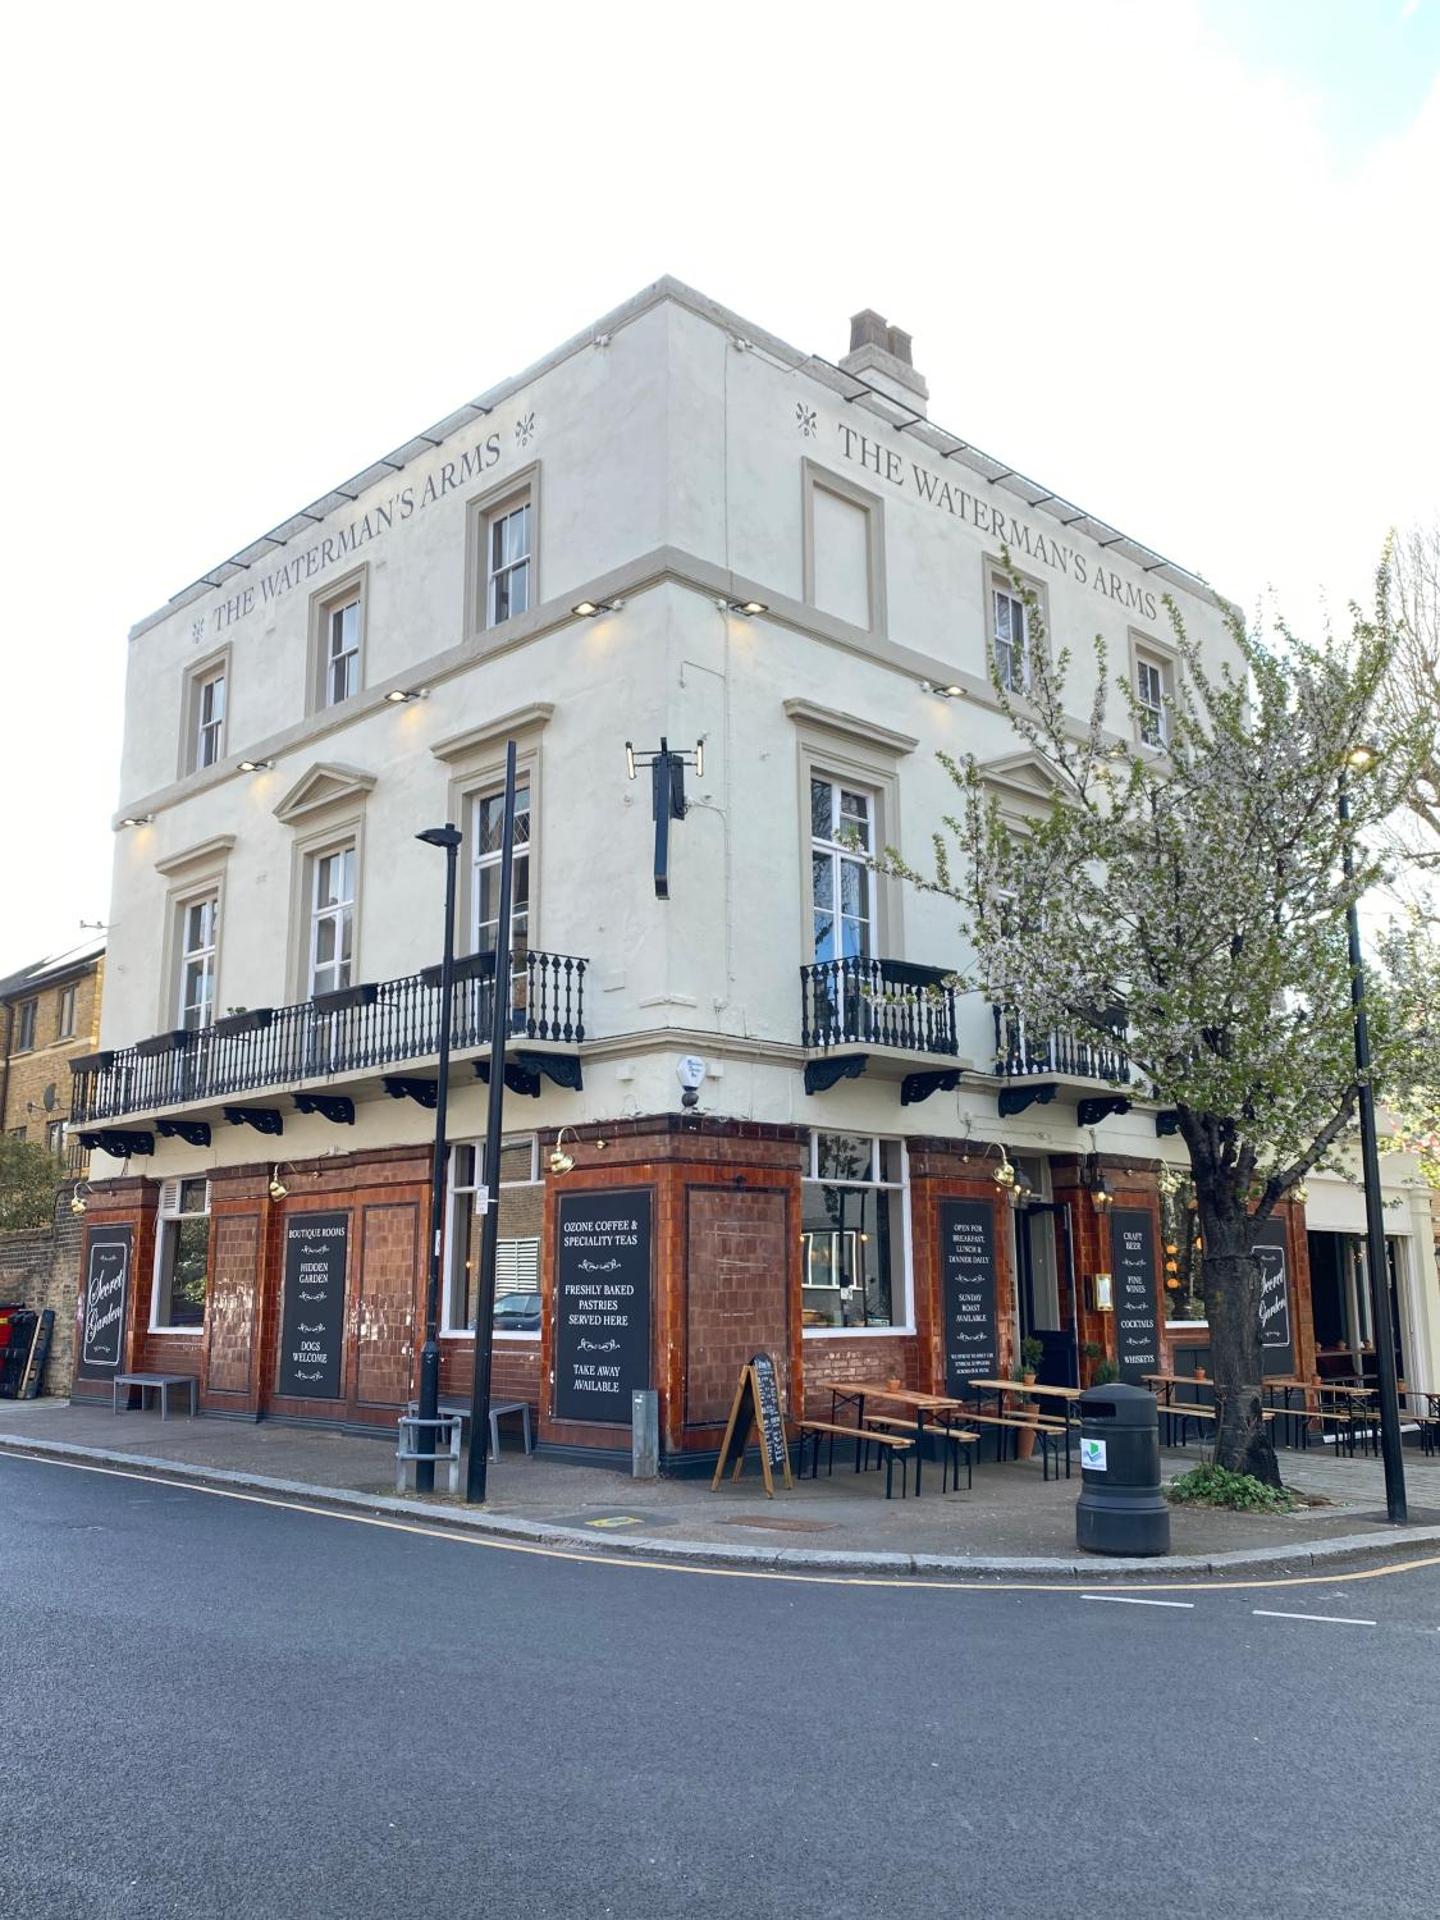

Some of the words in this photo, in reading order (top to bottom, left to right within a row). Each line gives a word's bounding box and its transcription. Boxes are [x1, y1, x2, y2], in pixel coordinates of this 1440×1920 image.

[838, 423, 905, 487] THE
[911, 464, 1088, 584] WATERMAN'S
[1093, 565, 1158, 621] ARMS
[213, 586, 255, 632] THE
[260, 486, 415, 604] WATERMAN'S
[420, 432, 501, 509] ARMS
[564, 1221, 594, 1232] OZONE
[595, 1220, 629, 1231] COFFEE
[631, 1220, 638, 1230] &
[954, 1224, 970, 1232] OPEN
[289, 1229, 321, 1239] BOUTIQUE
[322, 1227, 345, 1237] ROOMS
[1123, 1232, 1142, 1241] CRAFT
[564, 1236, 613, 1247] SPECIALITY
[615, 1235, 638, 1245] TEAS
[1126, 1241, 1142, 1250] BEER
[956, 1245, 976, 1253] LUNCH
[973, 1256, 990, 1264] DAILY
[300, 1263, 328, 1272] HIDDEN
[299, 1273, 328, 1284] GARDEN
[1128, 1276, 1142, 1285] FINE
[89, 1269, 124, 1307] Secret
[565, 1285, 602, 1295] FRESHLY
[603, 1285, 634, 1295] BAKED
[1126, 1285, 1146, 1294] WINES
[958, 1294, 982, 1302] SUNDAY
[579, 1300, 618, 1310] PASTRIES
[962, 1304, 981, 1312] ROAST
[568, 1315, 602, 1325] SERVED
[603, 1315, 629, 1326] HERE
[955, 1314, 987, 1322] AVAILABLE
[86, 1303, 122, 1344] Garden
[1121, 1319, 1154, 1328] COCKTAILS
[301, 1341, 321, 1351] DOGS
[292, 1352, 327, 1363] WELCOME
[1124, 1355, 1155, 1364] WHISKEYS
[573, 1364, 596, 1375] TAKE
[597, 1366, 621, 1377] AWAY
[573, 1380, 620, 1392] AVAILABLE
